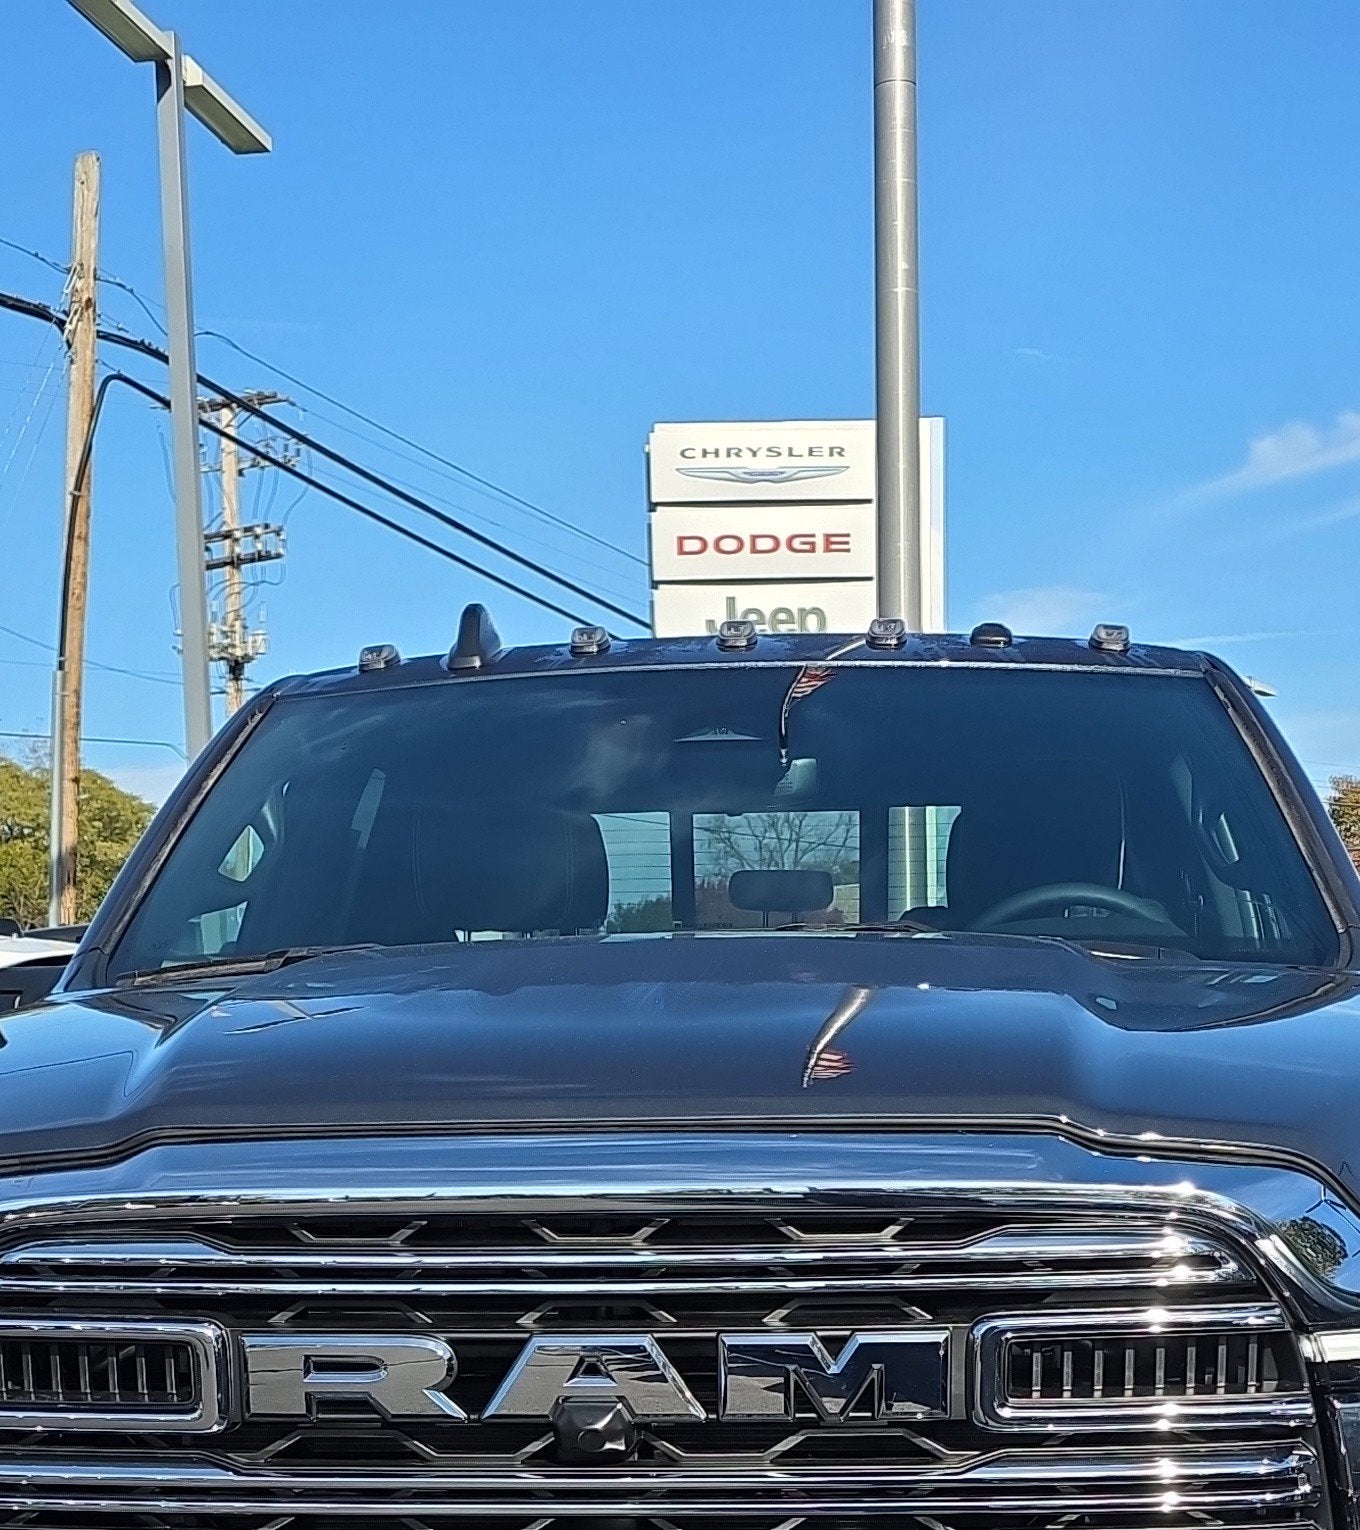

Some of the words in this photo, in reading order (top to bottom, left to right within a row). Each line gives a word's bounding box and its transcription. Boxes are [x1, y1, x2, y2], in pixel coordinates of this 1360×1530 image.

[679, 445, 846, 460] CHRYSLER
[676, 532, 852, 556] DODGE
[241, 1332, 953, 1423] RAM
